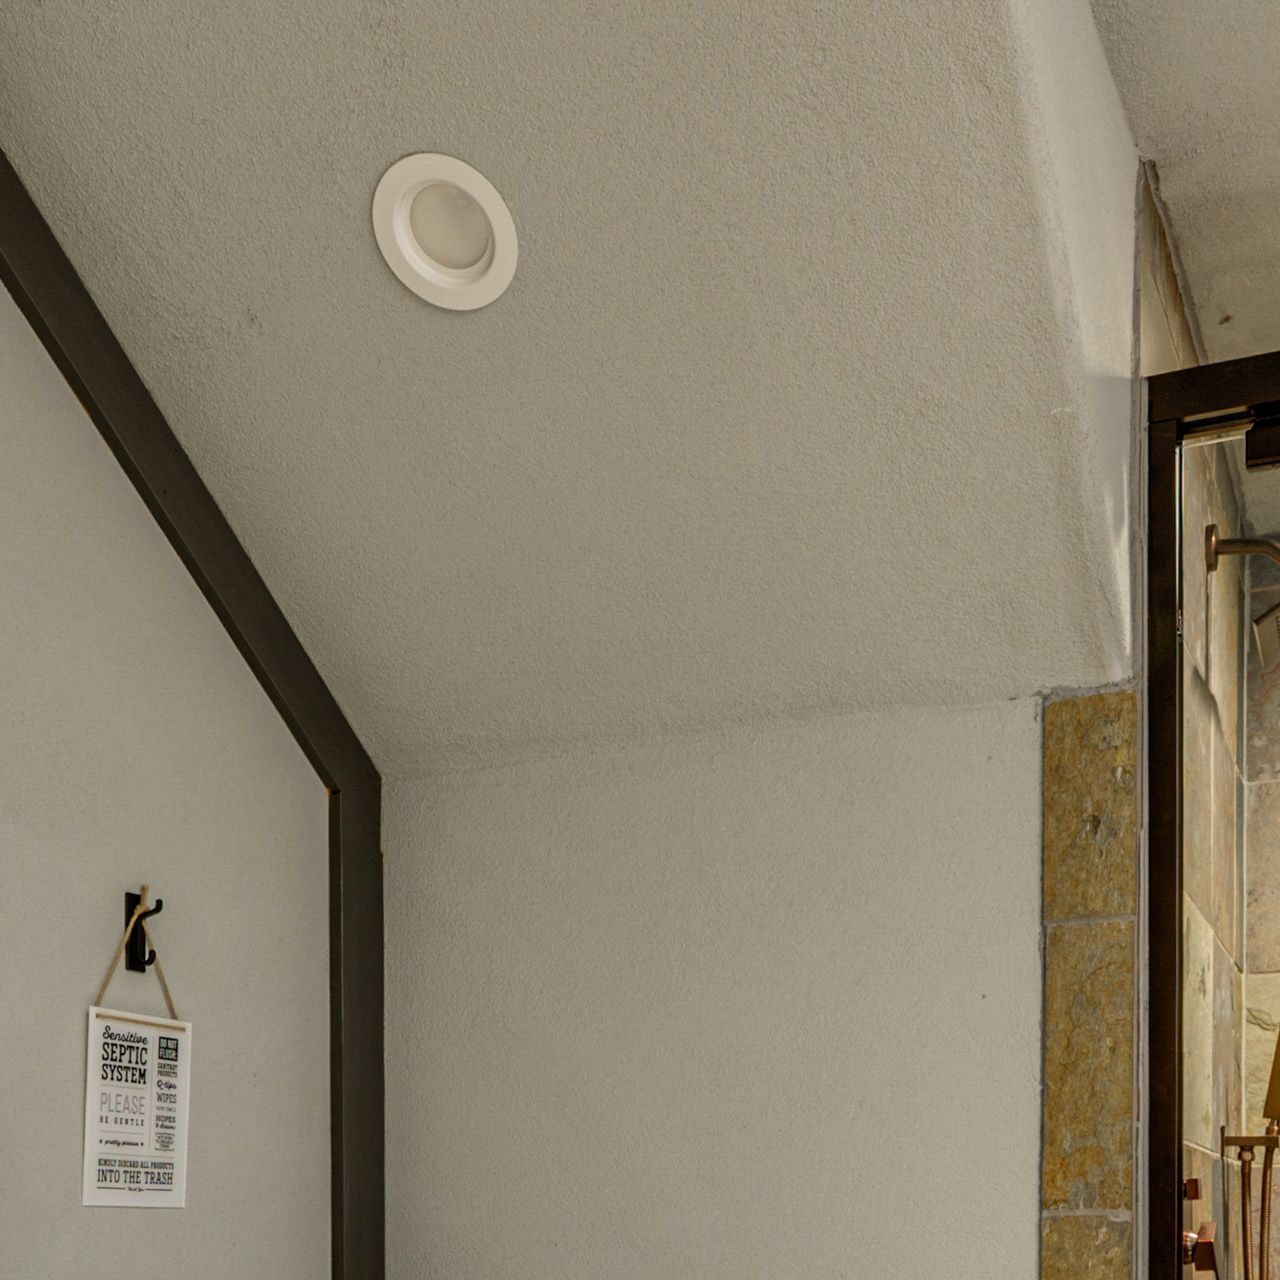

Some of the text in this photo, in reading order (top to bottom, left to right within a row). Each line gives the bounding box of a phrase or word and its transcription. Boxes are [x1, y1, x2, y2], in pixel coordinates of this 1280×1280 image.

[103, 1025, 148, 1045] Sensitive
[102, 1042, 147, 1065] SEPTIC
[101, 1064, 146, 1085] SYSTEM
[100, 1092, 145, 1115] PLEASE
[157, 1092, 176, 1104] WIPES
[97, 1169, 173, 1185] INTO THE TRASH
